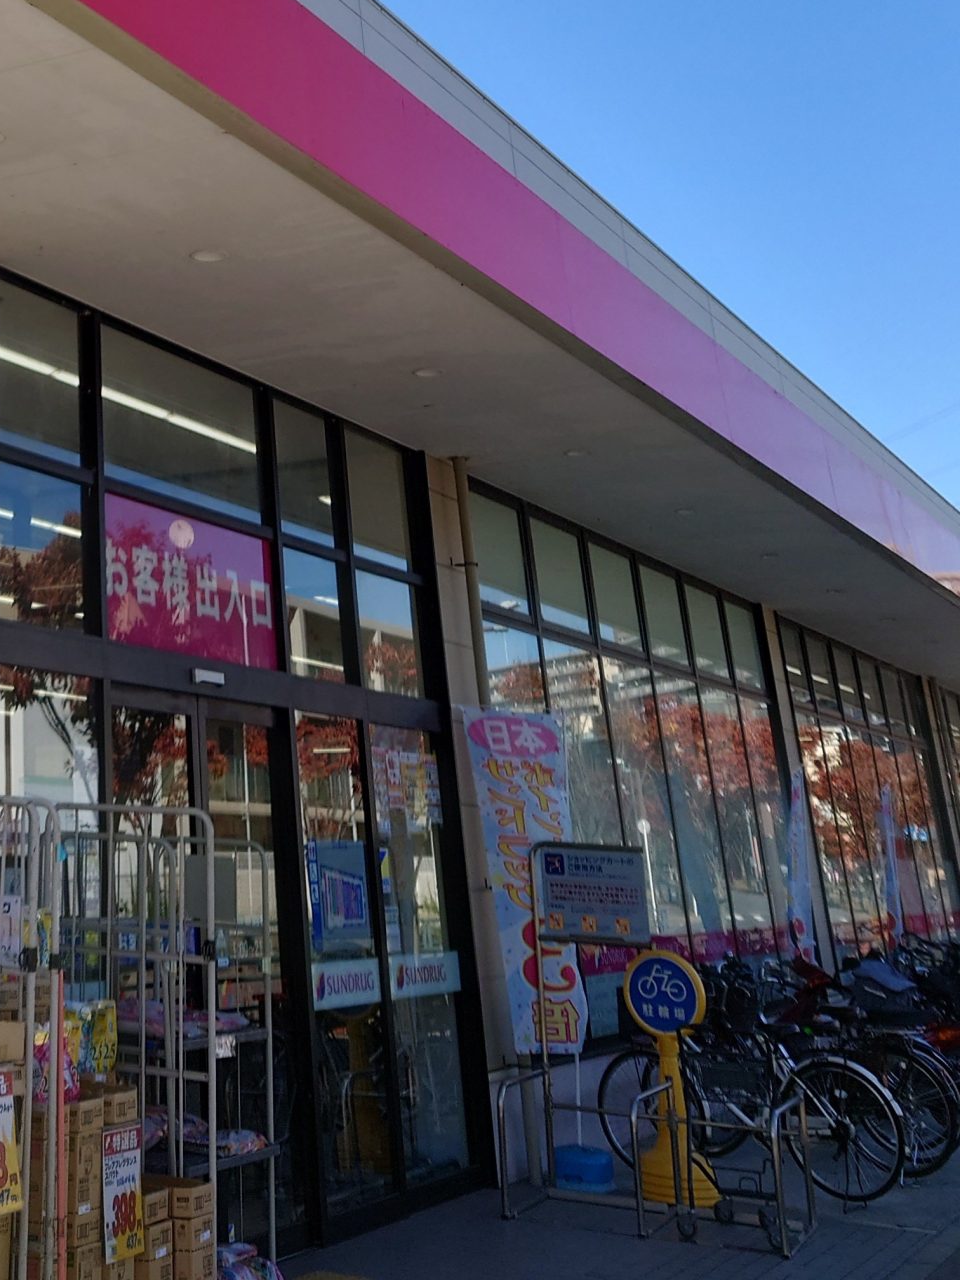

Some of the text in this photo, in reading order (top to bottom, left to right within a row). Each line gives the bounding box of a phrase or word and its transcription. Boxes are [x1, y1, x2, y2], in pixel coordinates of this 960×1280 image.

[105, 538, 273, 629] お客様出入口
[326, 970, 375, 997] SUNDRUG
[404, 959, 448, 987] SUNDRUG
[642, 1002, 686, 1022] 駐輪場
[111, 1190, 138, 1239] 398
